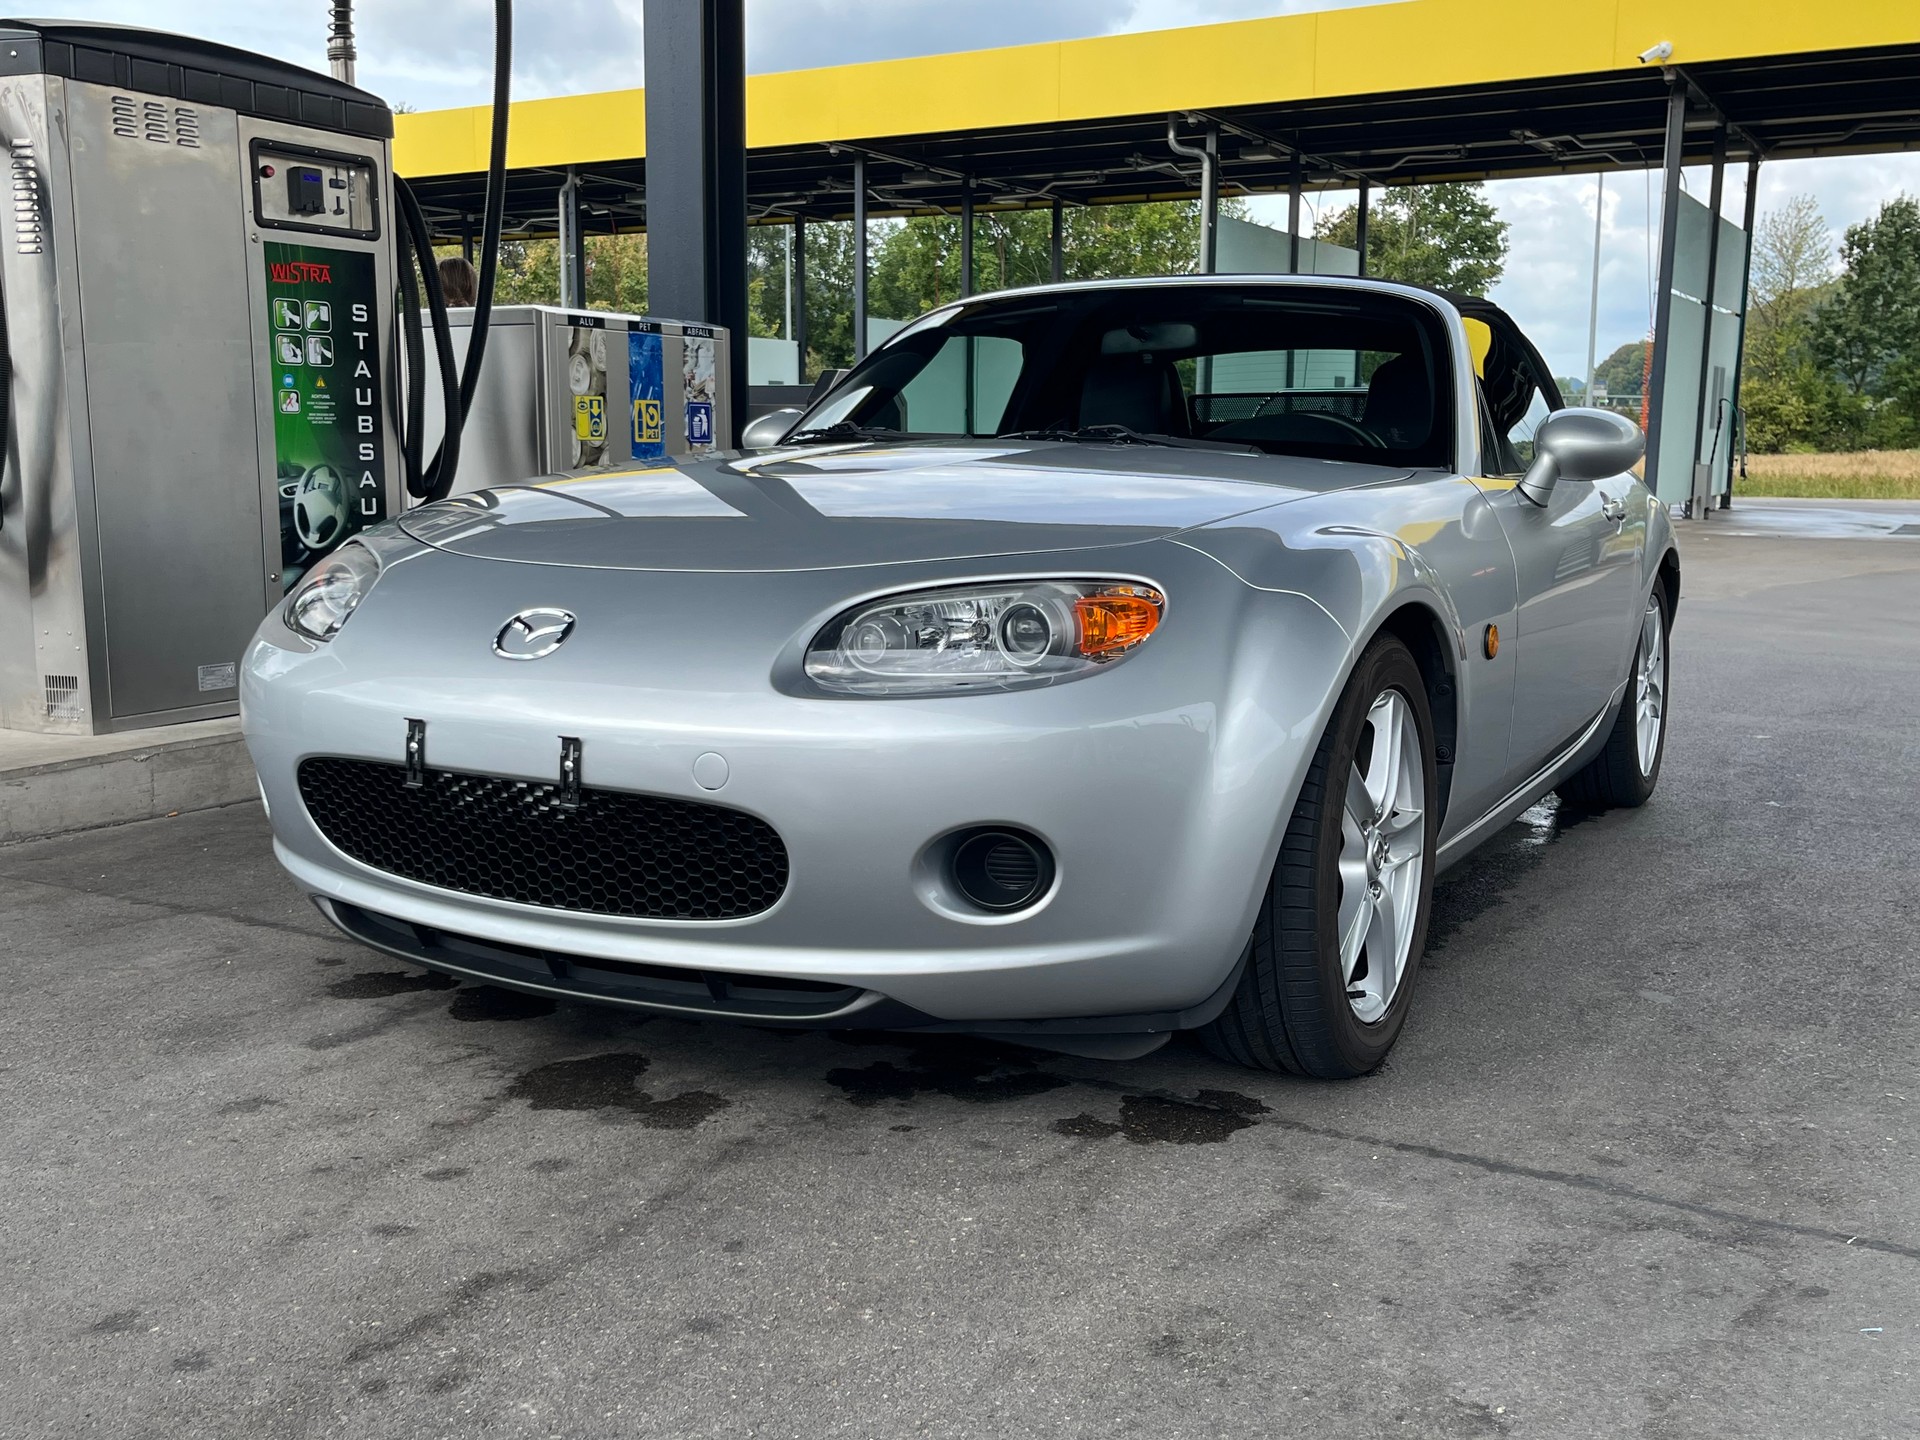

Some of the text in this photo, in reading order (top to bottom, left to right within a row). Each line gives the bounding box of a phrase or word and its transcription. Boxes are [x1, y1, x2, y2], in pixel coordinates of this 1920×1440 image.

[270, 262, 332, 284] WISTRA
[579, 316, 594, 327] ALU
[638, 322, 651, 332] PET
[687, 327, 710, 337] ABFALL
[352, 304, 377, 531] STAUBSAU
[647, 429, 659, 438] PET
